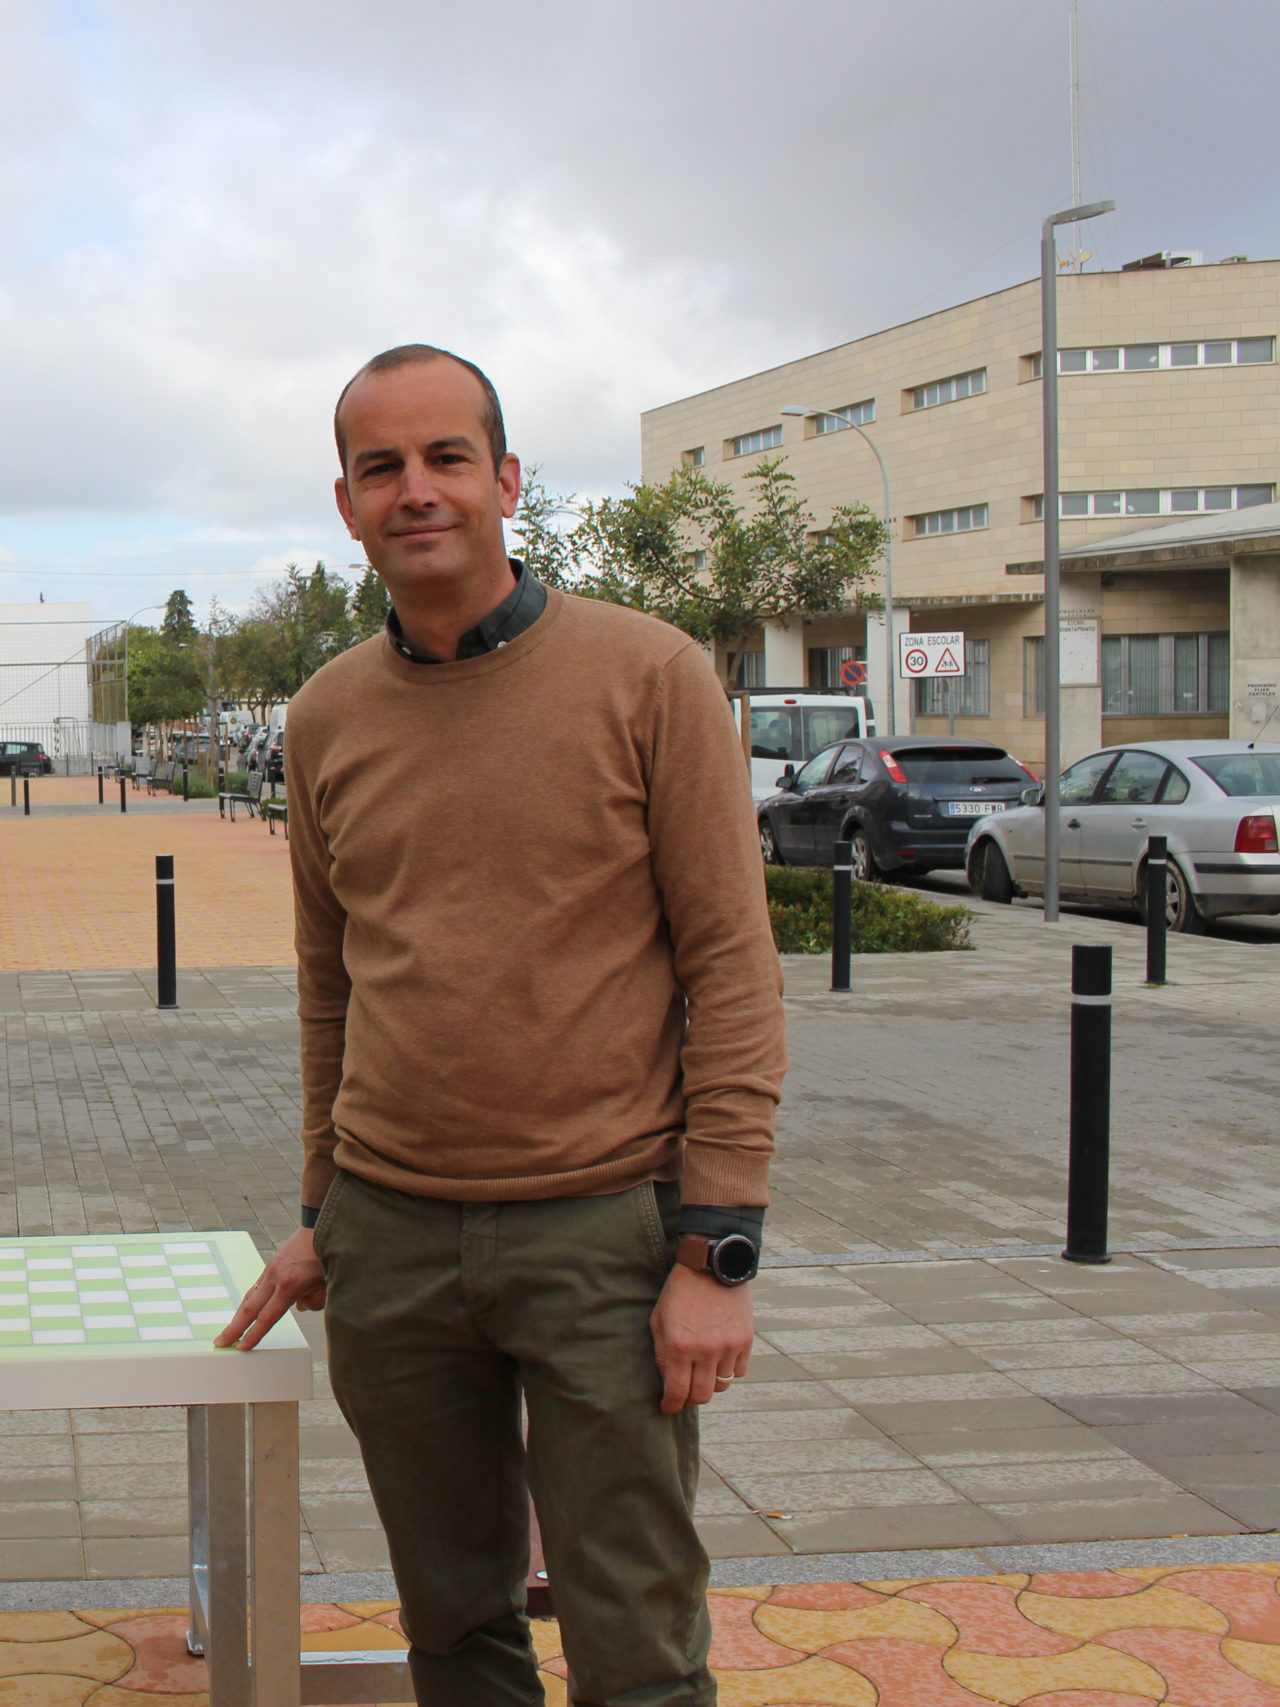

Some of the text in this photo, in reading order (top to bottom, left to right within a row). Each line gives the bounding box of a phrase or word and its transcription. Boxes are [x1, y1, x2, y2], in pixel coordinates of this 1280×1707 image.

[905, 635, 960, 647] ZONA ESCOLAR
[910, 656, 924, 666] 30
[955, 803, 981, 813] 5330
